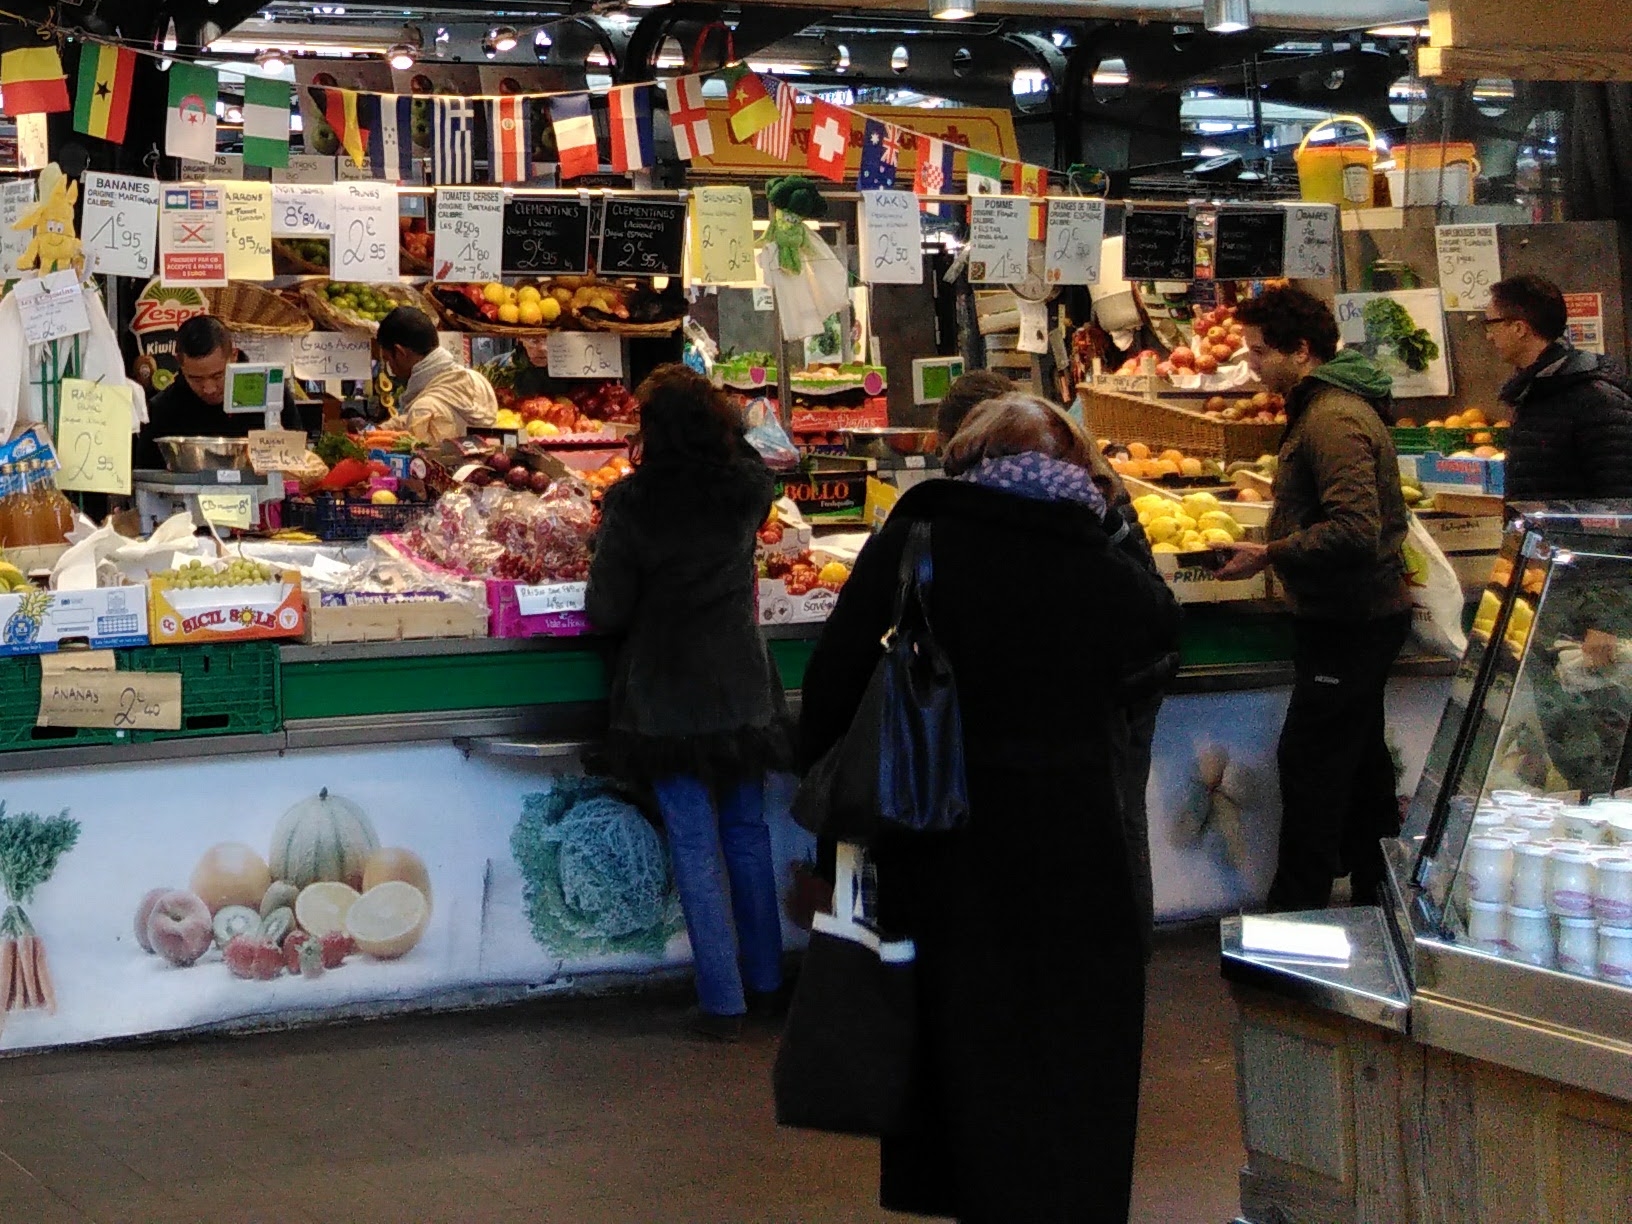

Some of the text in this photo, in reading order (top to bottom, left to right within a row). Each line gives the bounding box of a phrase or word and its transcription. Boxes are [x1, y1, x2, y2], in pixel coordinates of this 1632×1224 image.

[96, 178, 150, 193] BANANES
[442, 191, 499, 202] TOMATES CERISES
[876, 194, 909, 209] KAKIS
[985, 200, 1013, 209] POMME
[133, 302, 207, 330] Zespri
[784, 481, 849, 501] BOLLO
[182, 610, 226, 634] SICIL
